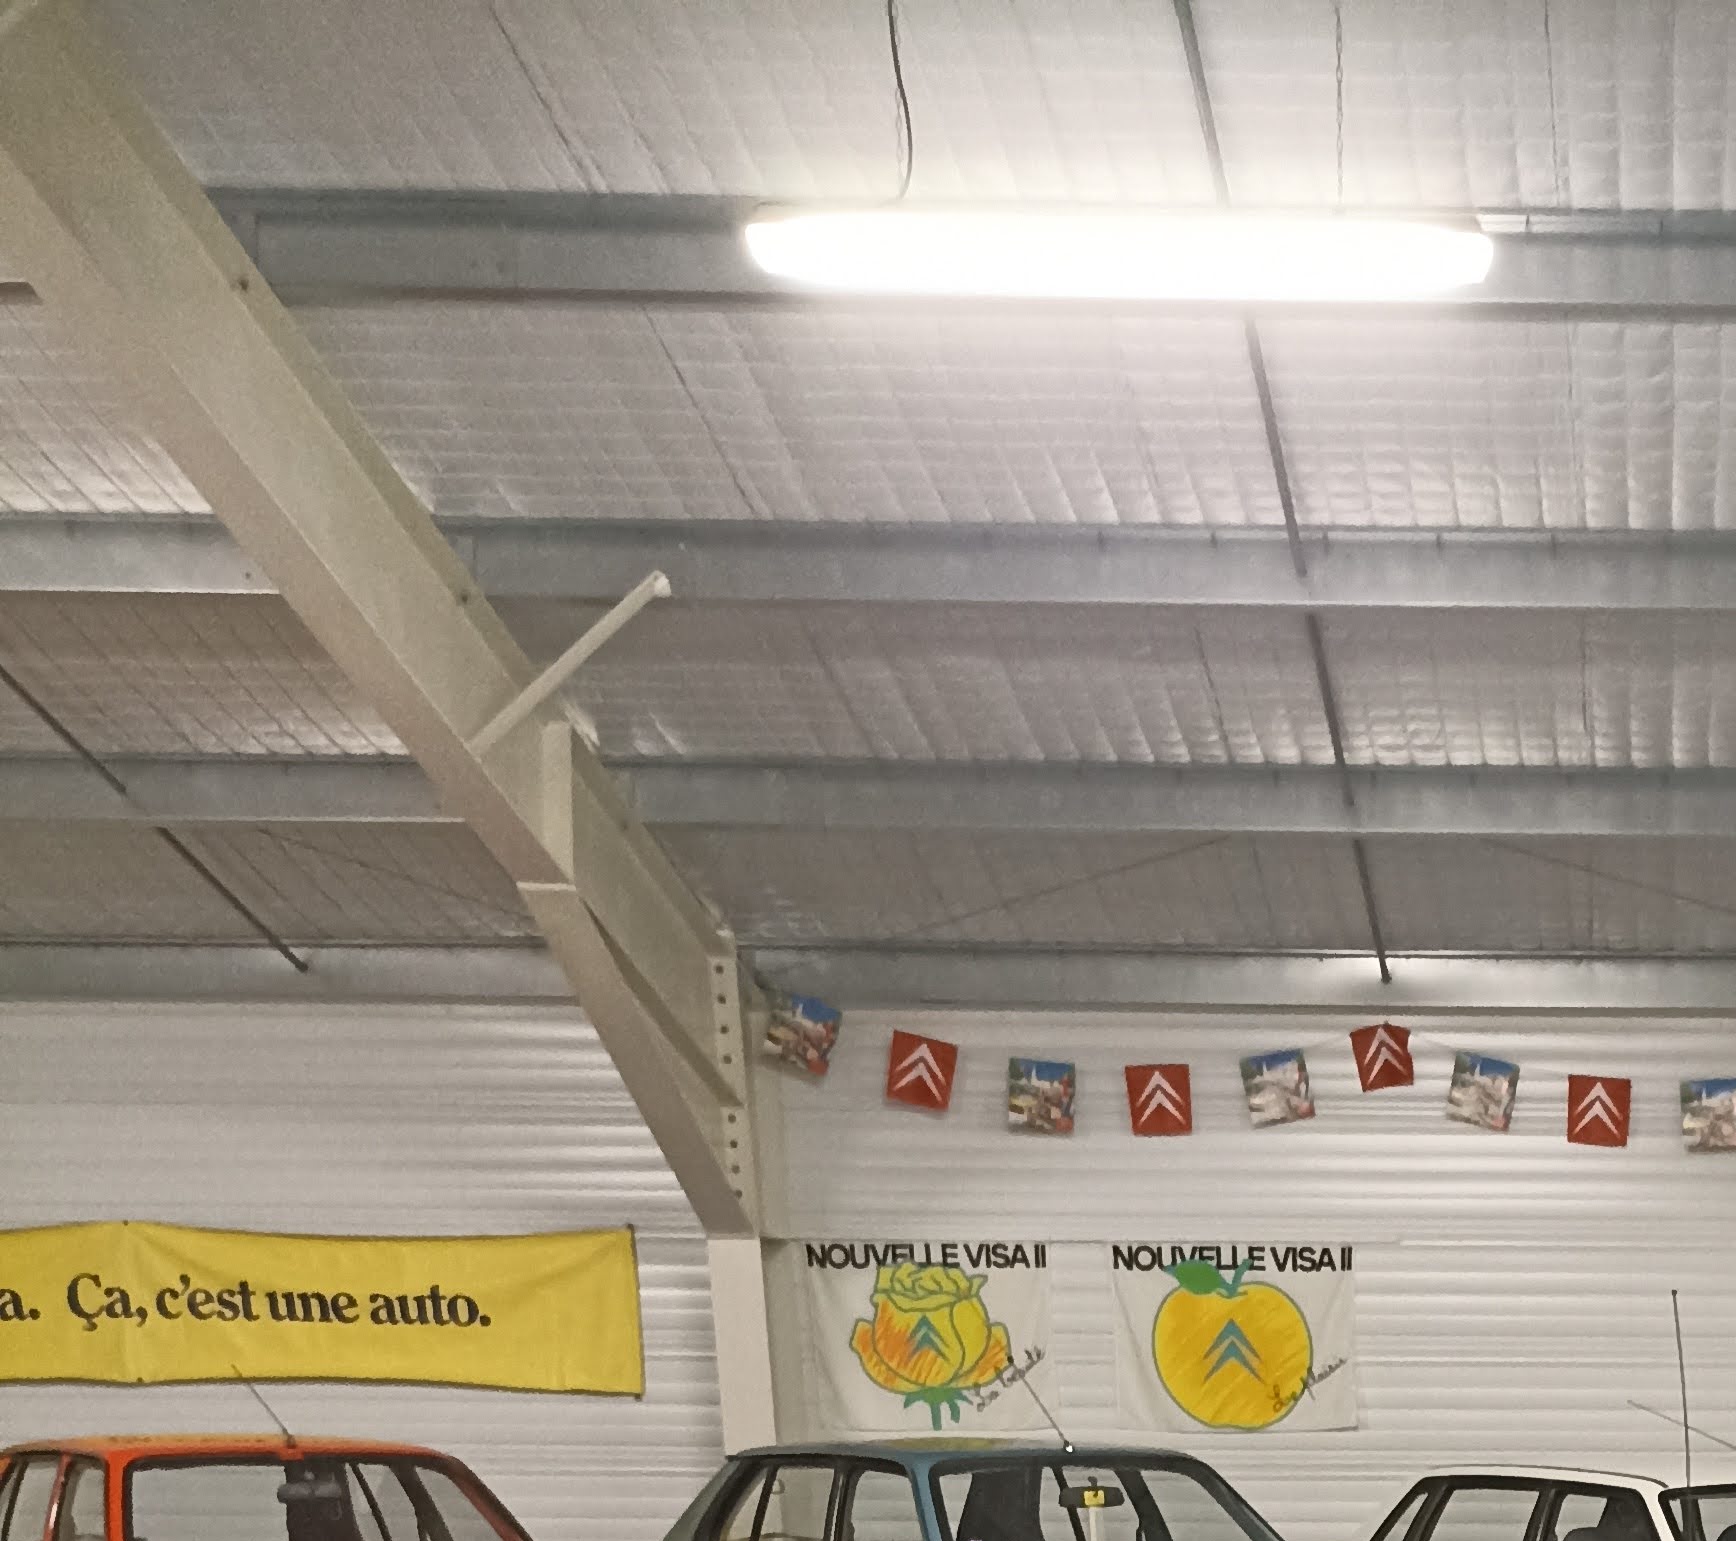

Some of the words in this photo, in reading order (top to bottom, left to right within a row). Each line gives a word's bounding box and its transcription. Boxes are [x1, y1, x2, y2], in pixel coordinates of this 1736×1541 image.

[963, 1243, 1031, 1269] VISA
[1270, 1246, 1337, 1272] VISA
[67, 1272, 148, 1331] Ça,
[265, 1290, 359, 1323] une
[369, 1284, 491, 1327] auto.
